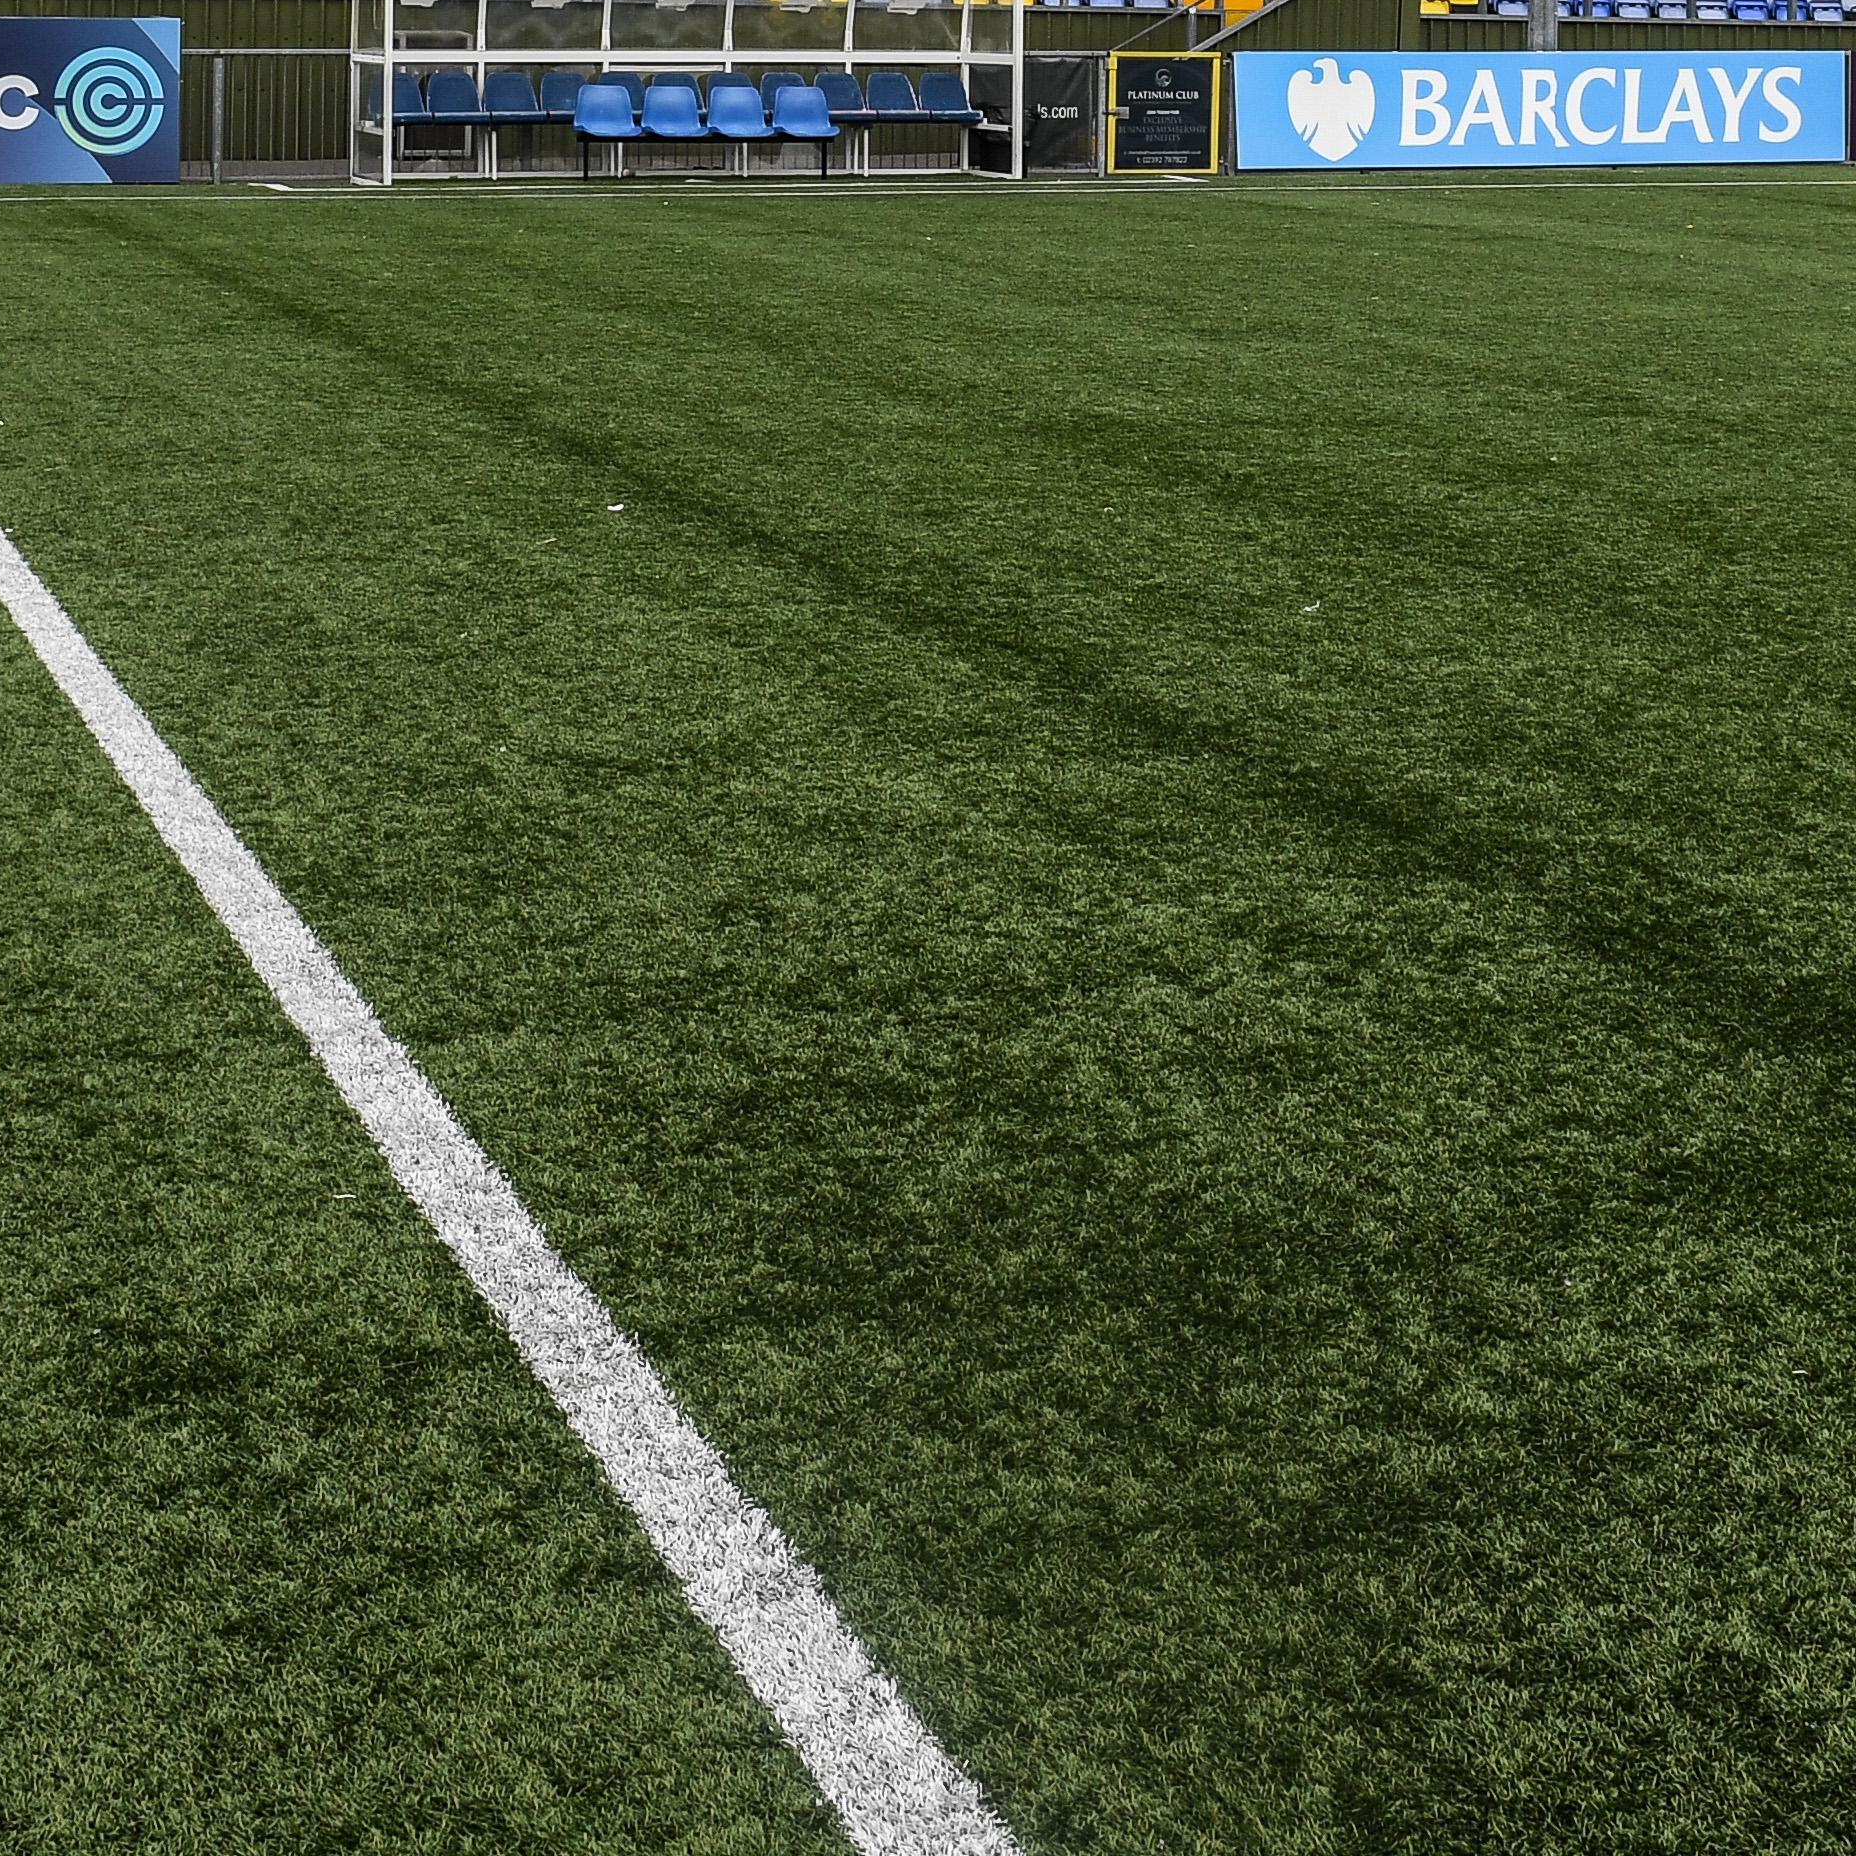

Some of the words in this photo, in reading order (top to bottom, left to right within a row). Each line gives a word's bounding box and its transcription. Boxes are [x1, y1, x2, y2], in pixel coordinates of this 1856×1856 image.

[1127, 91, 1174, 101] PLATINUM
[1175, 90, 1200, 100] CLUB
[1399, 66, 1802, 147] BARCLAYS
